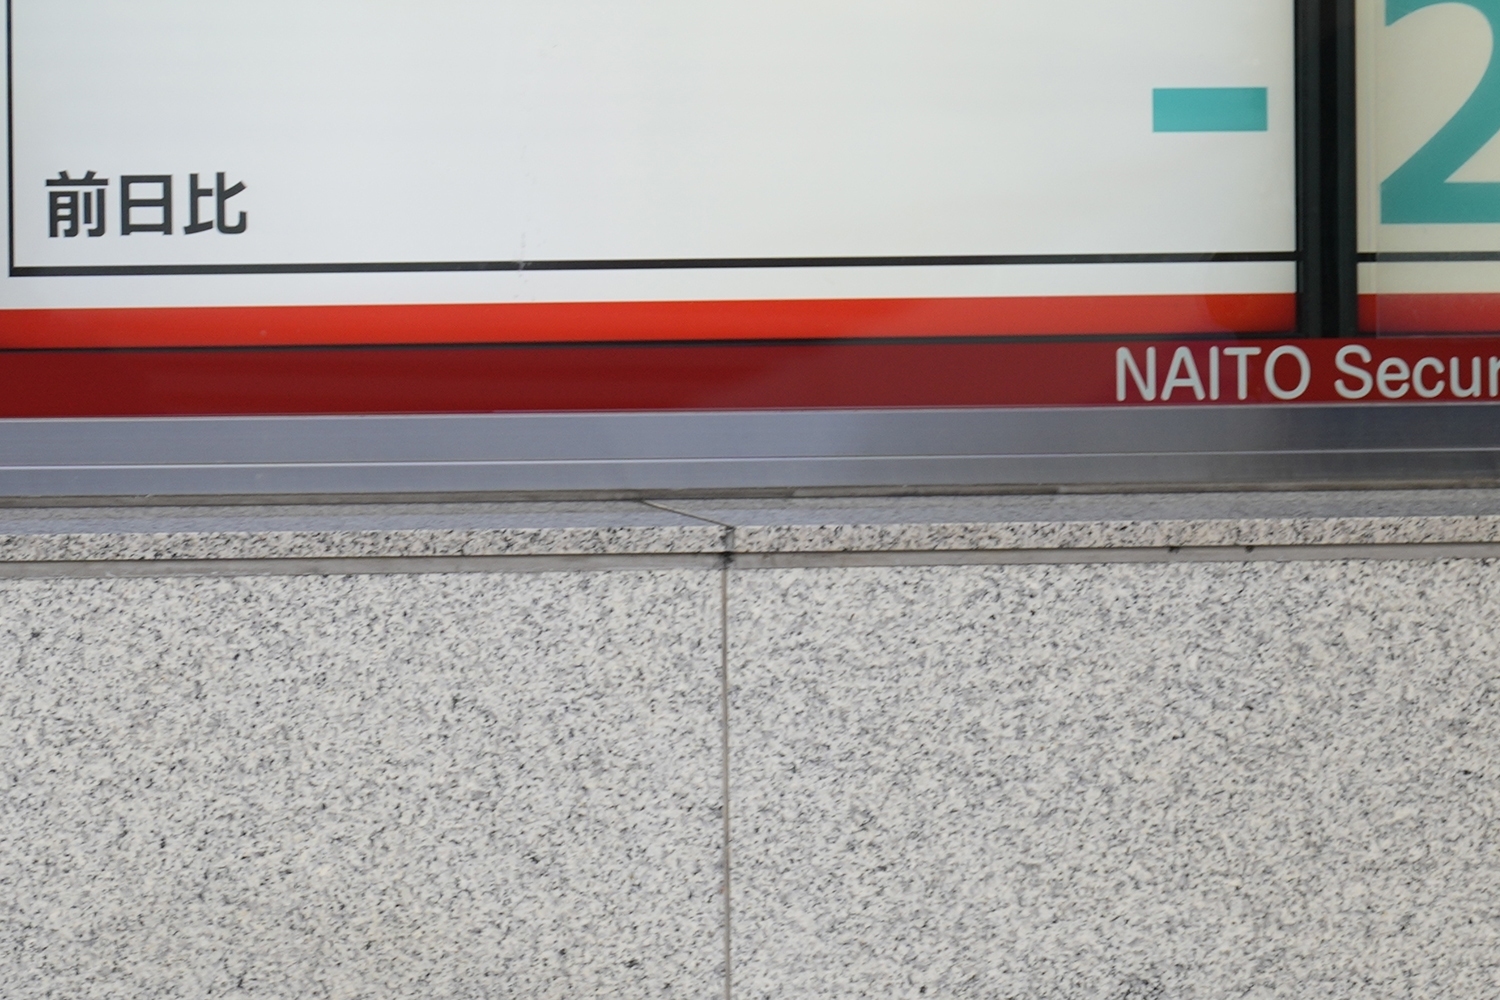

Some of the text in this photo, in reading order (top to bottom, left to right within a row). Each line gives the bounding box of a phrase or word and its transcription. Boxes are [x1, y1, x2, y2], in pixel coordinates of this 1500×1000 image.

[45, 170, 247, 238] 前日比
[1116, 345, 1310, 401] NAITO
